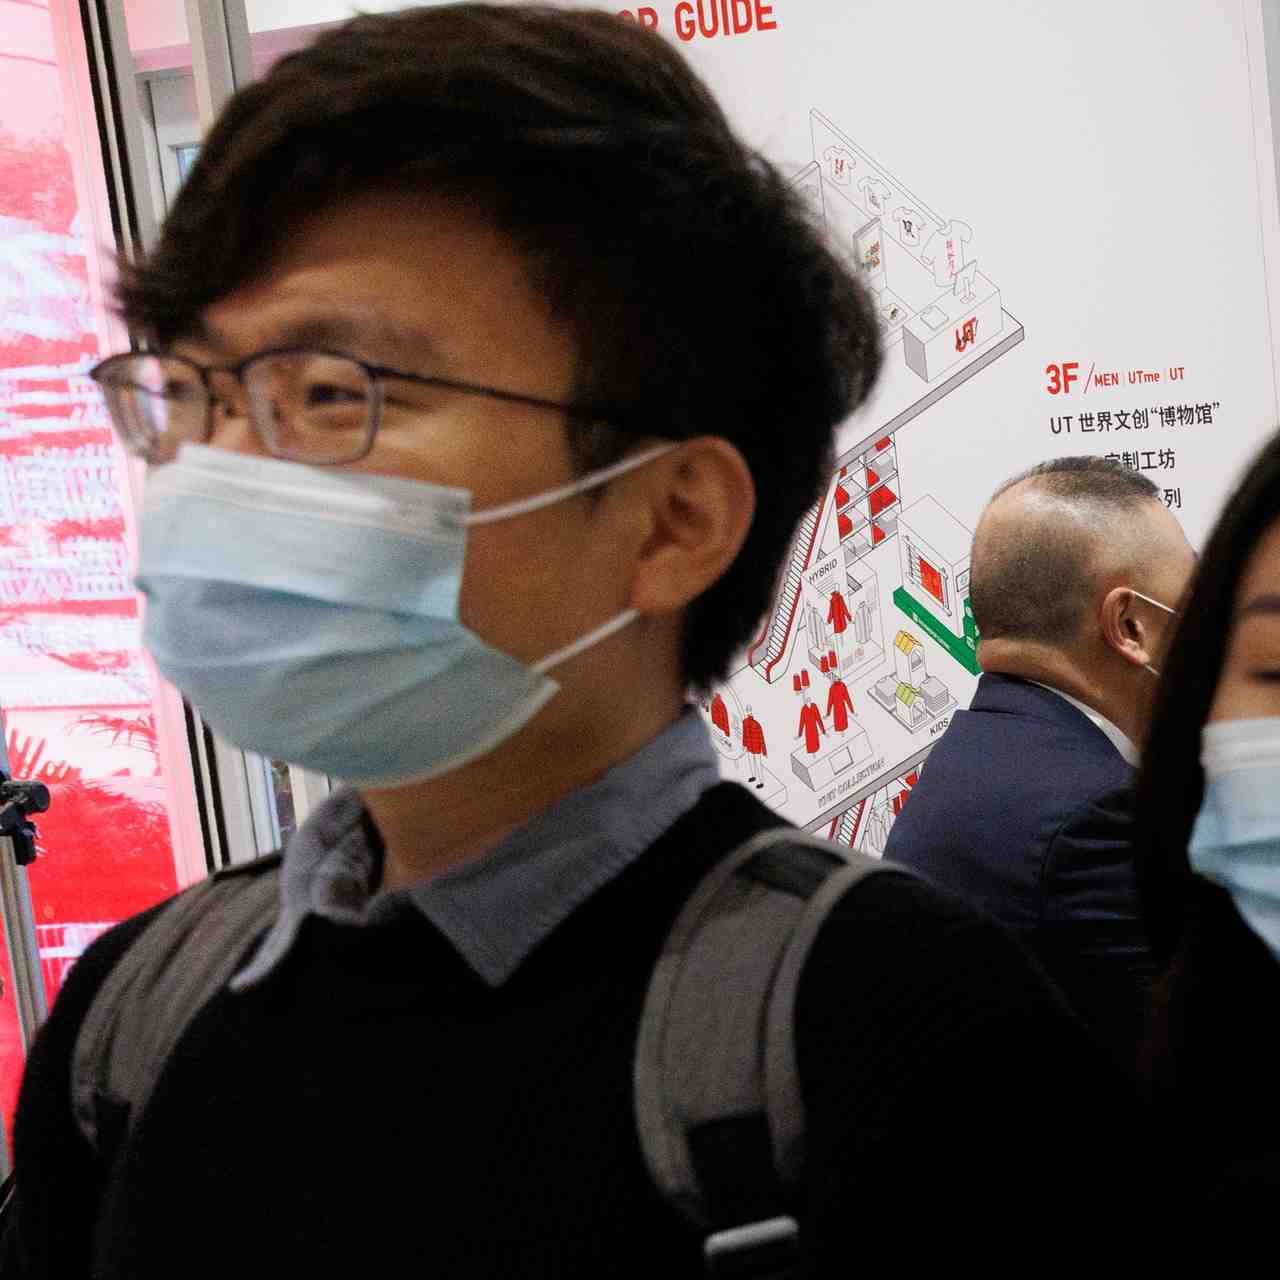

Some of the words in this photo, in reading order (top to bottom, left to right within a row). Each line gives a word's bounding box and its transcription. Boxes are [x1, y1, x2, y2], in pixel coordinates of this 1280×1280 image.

[674, 0, 776, 41] GUIDE
[1046, 362, 1079, 395] 3F
[1095, 372, 1119, 387] MEN
[1128, 370, 1160, 385] UTme
[1169, 367, 1185, 381] UT
[1050, 415, 1073, 434] UT
[1158, 488, 1181, 509] 列
[809, 558, 838, 583] HYBRID
[929, 717, 949, 737] KIDS
